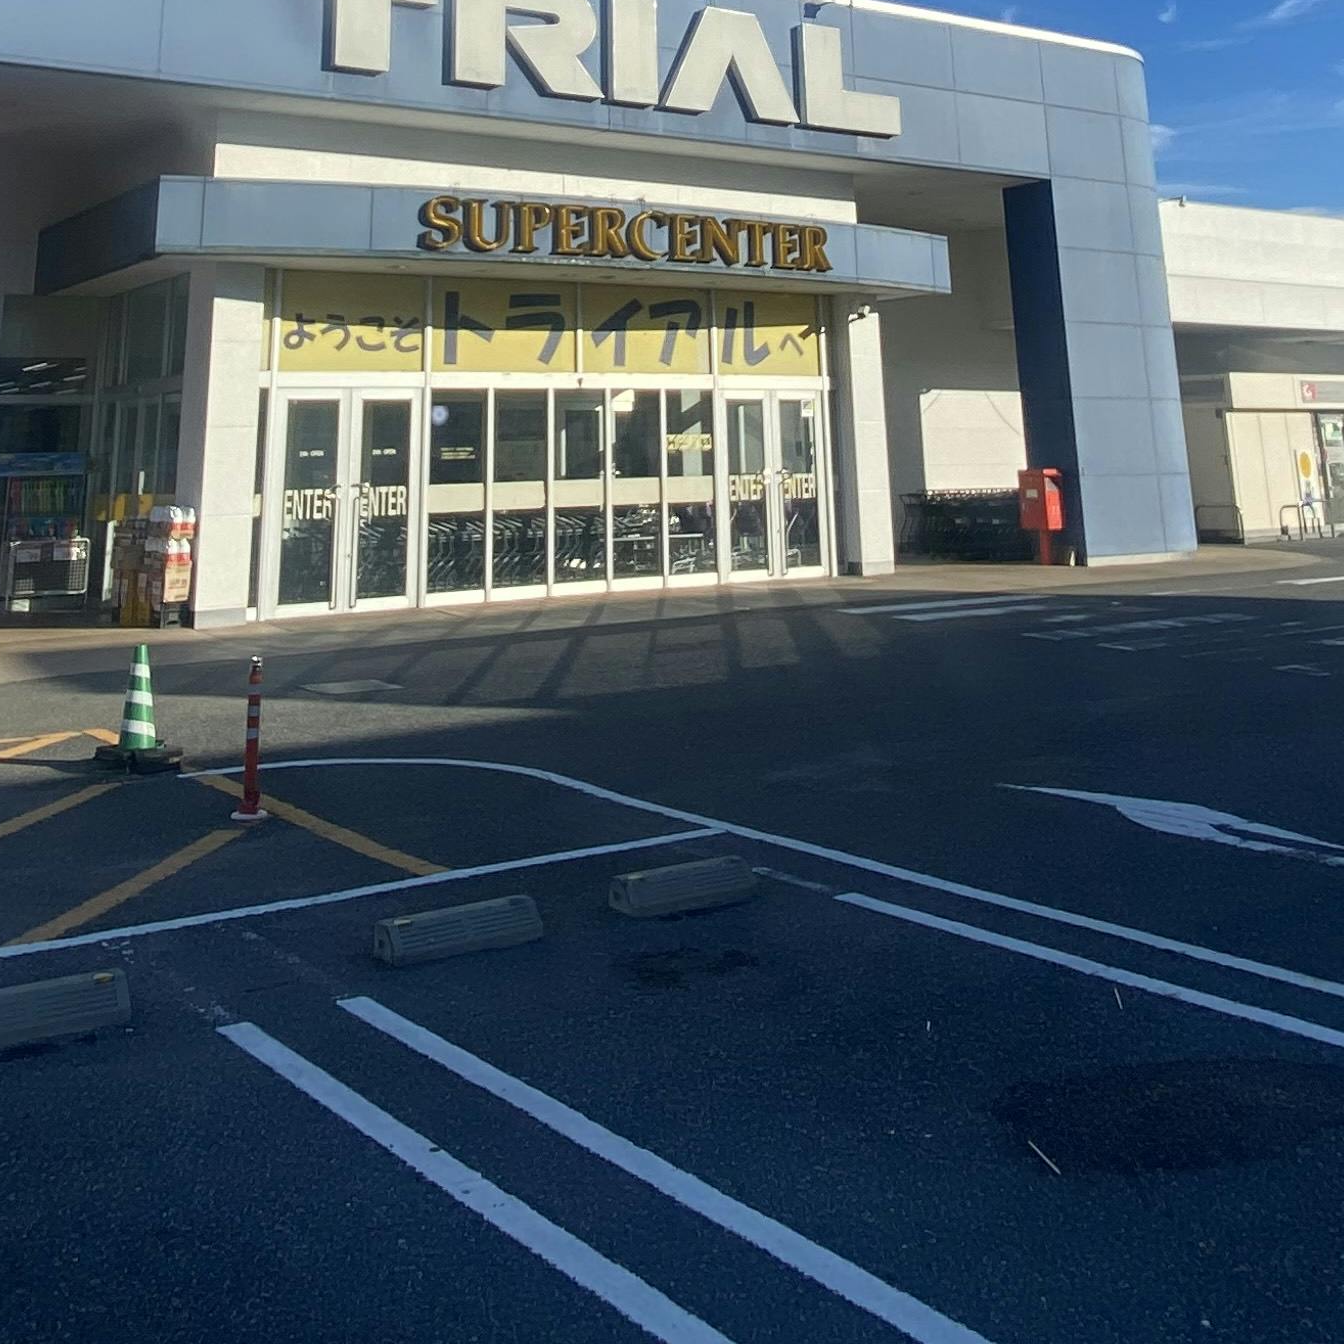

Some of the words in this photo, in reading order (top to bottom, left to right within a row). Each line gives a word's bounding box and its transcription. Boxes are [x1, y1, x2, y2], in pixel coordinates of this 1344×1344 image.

[418, 195, 833, 273] SUPERCENTER
[283, 312, 422, 353] ようこそ
